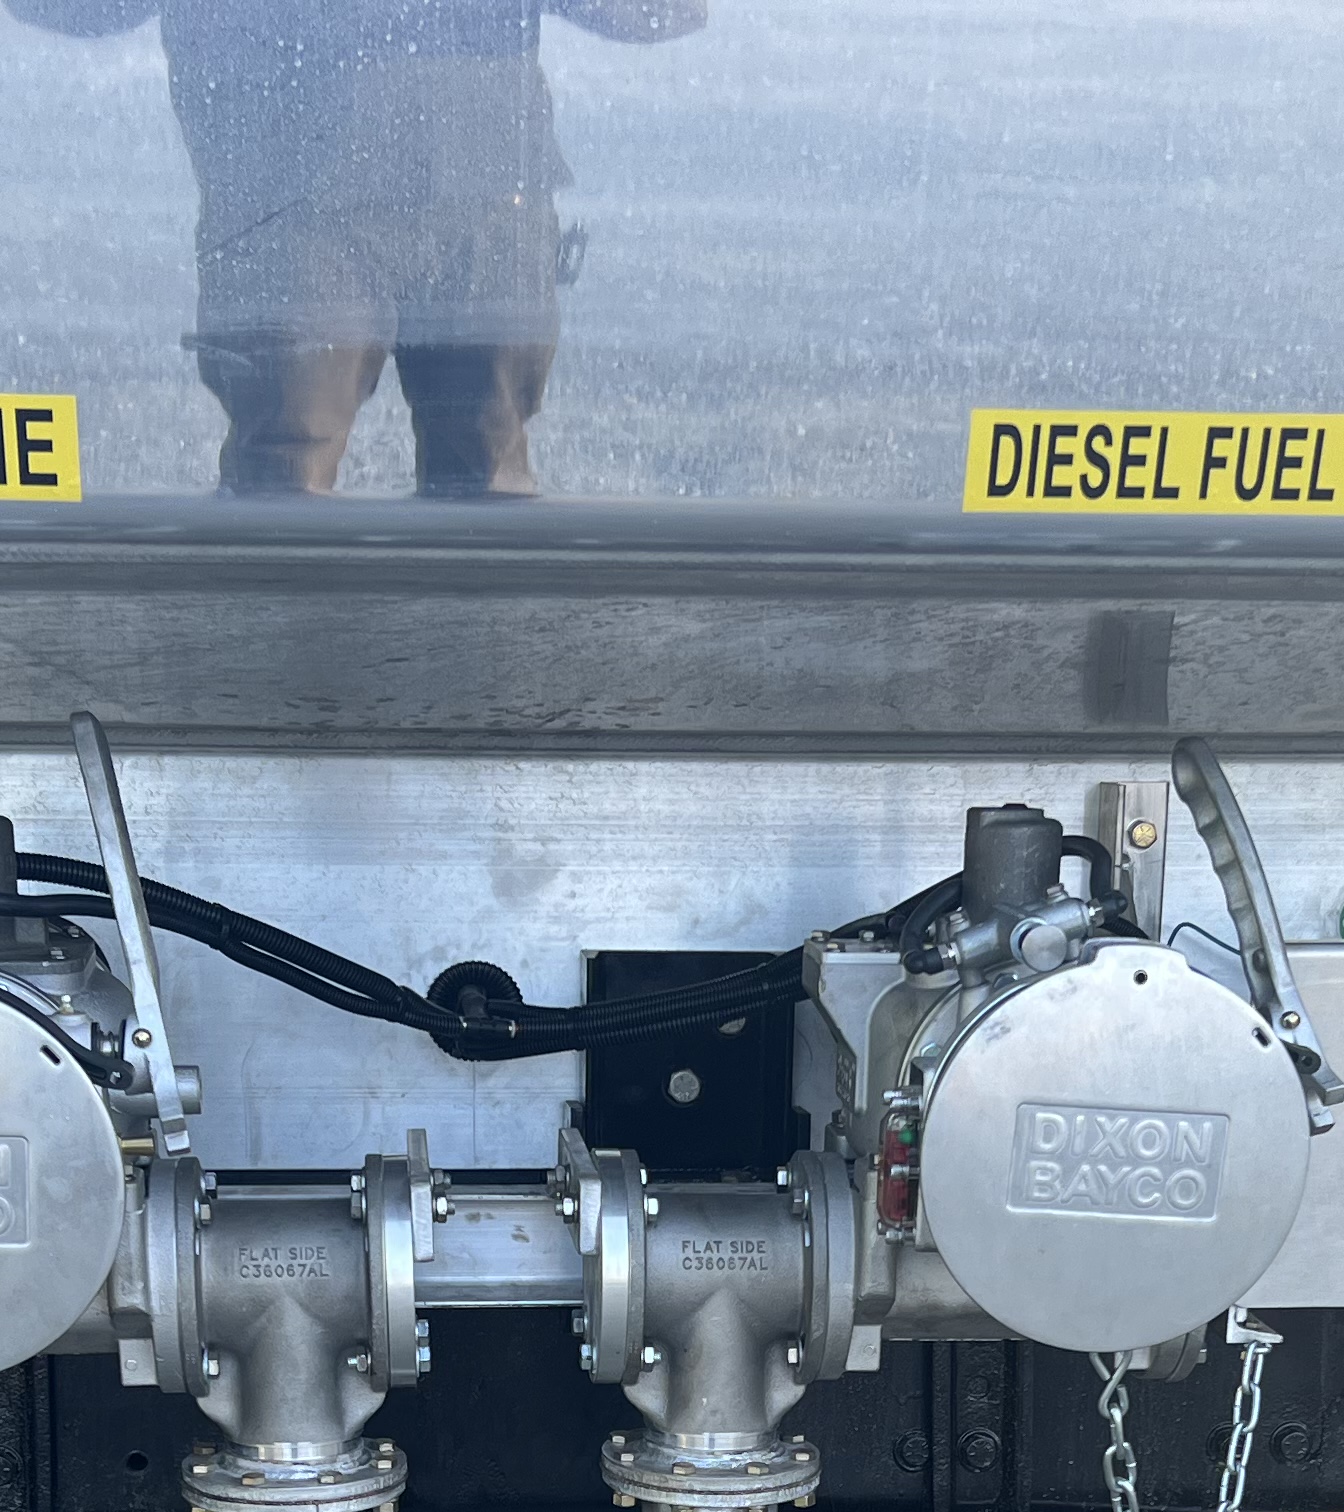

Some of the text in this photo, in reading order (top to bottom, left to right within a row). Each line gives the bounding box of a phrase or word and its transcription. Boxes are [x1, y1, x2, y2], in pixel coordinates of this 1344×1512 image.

[987, 423, 1336, 502] DIESEL FUEL
[1031, 1112, 1213, 1165] DIXON
[1025, 1160, 1207, 1212] BAYCO
[238, 1246, 328, 1261] FLAT SIDE
[681, 1240, 767, 1254] FLAT SIDE
[239, 1263, 330, 1279] C36067AL
[682, 1256, 769, 1271] C36067AL
